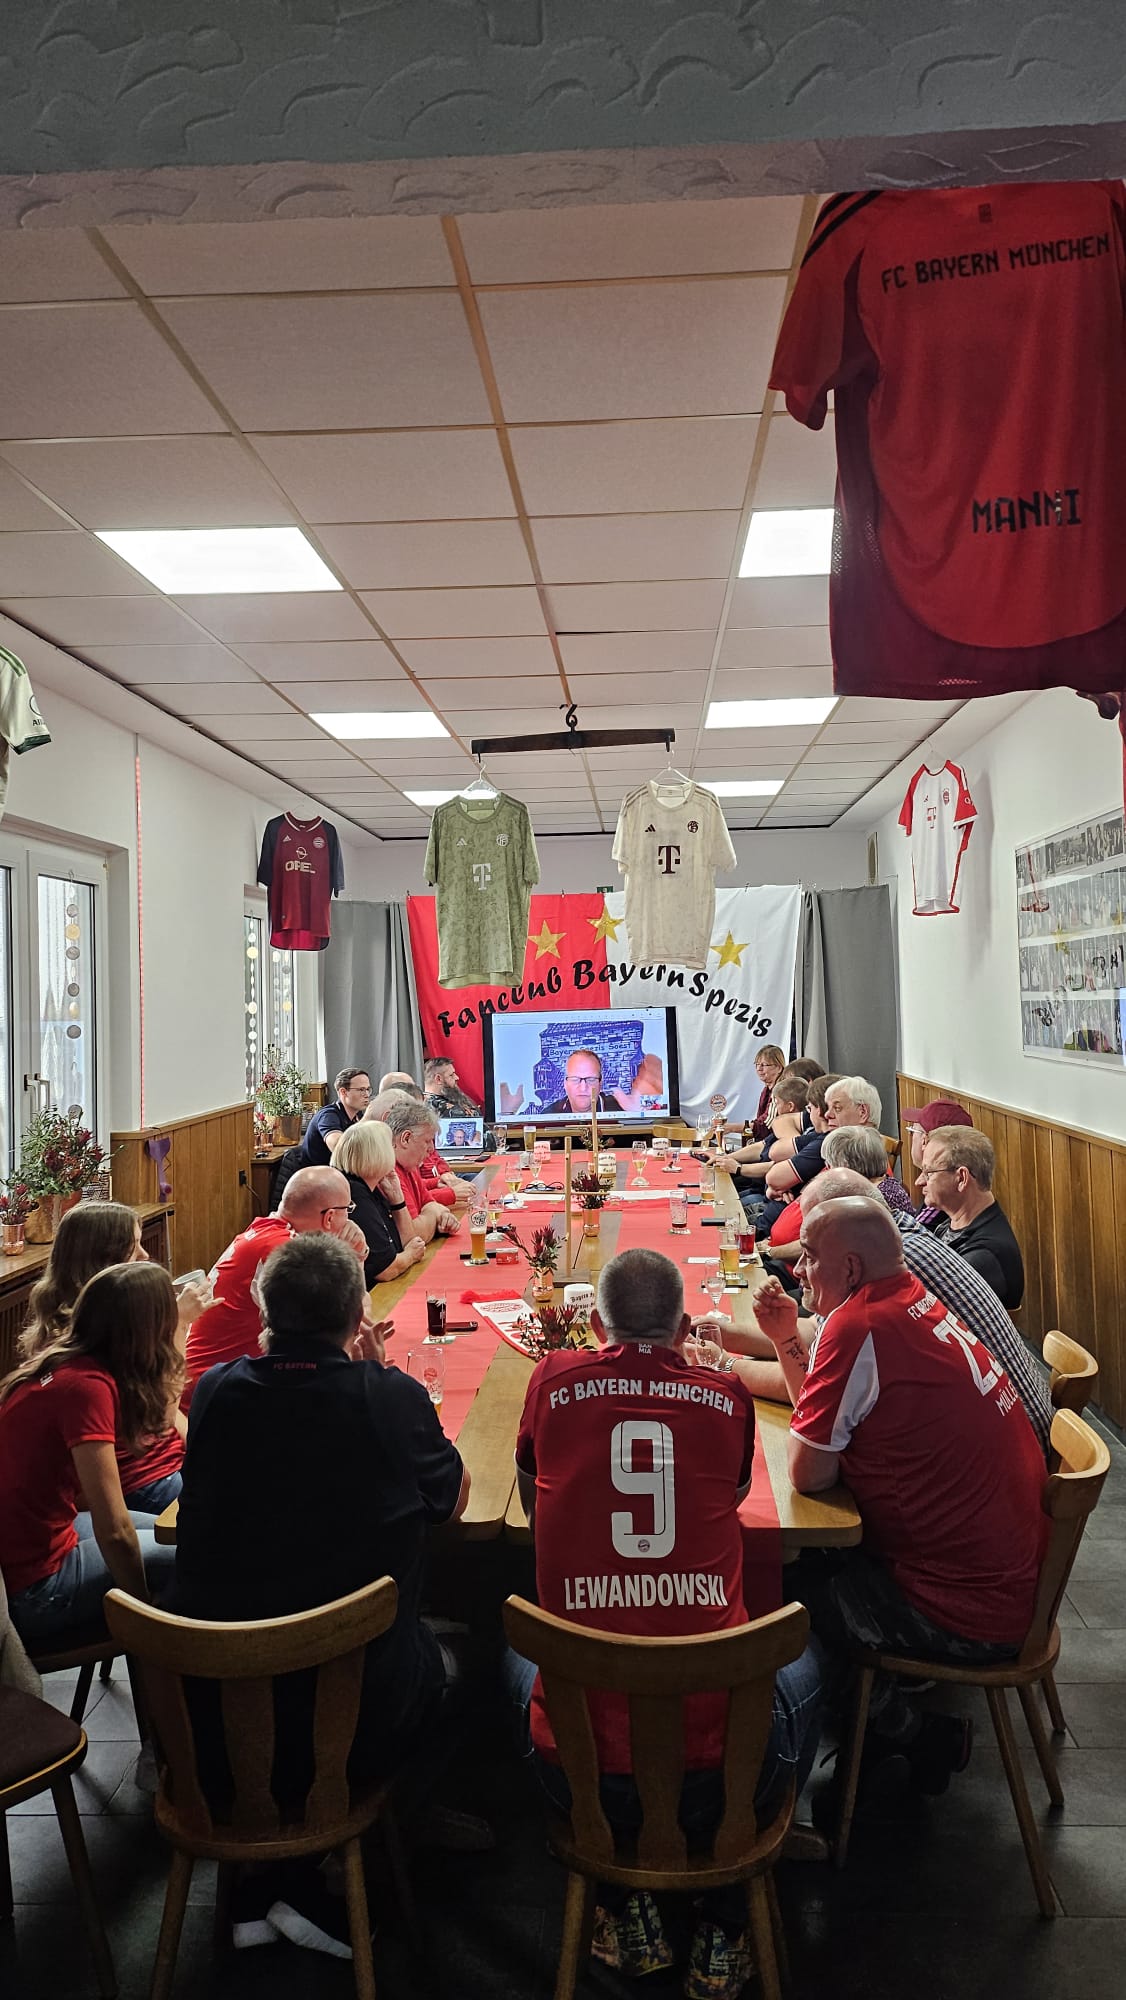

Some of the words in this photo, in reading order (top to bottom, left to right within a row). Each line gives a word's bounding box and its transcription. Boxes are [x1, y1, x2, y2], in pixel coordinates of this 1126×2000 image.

[881, 265, 908, 294] FC
[914, 250, 1000, 285] BAYERN
[1008, 232, 1110, 270] MÜNCHEN
[971, 488, 1082, 534] MANNI
[284, 860, 316, 875] OPEL
[472, 863, 492, 892] T
[657, 844, 681, 875] T
[638, 1347, 653, 1355] MIA
[549, 1386, 570, 1410] FC
[574, 1378, 643, 1401] BAYERN
[649, 1380, 734, 1417] MÜNCHEN
[995, 1380, 1019, 1417] MÜLLE
[610, 1420, 676, 1559] 9
[564, 1573, 729, 1611] LEWANDOWSKI
